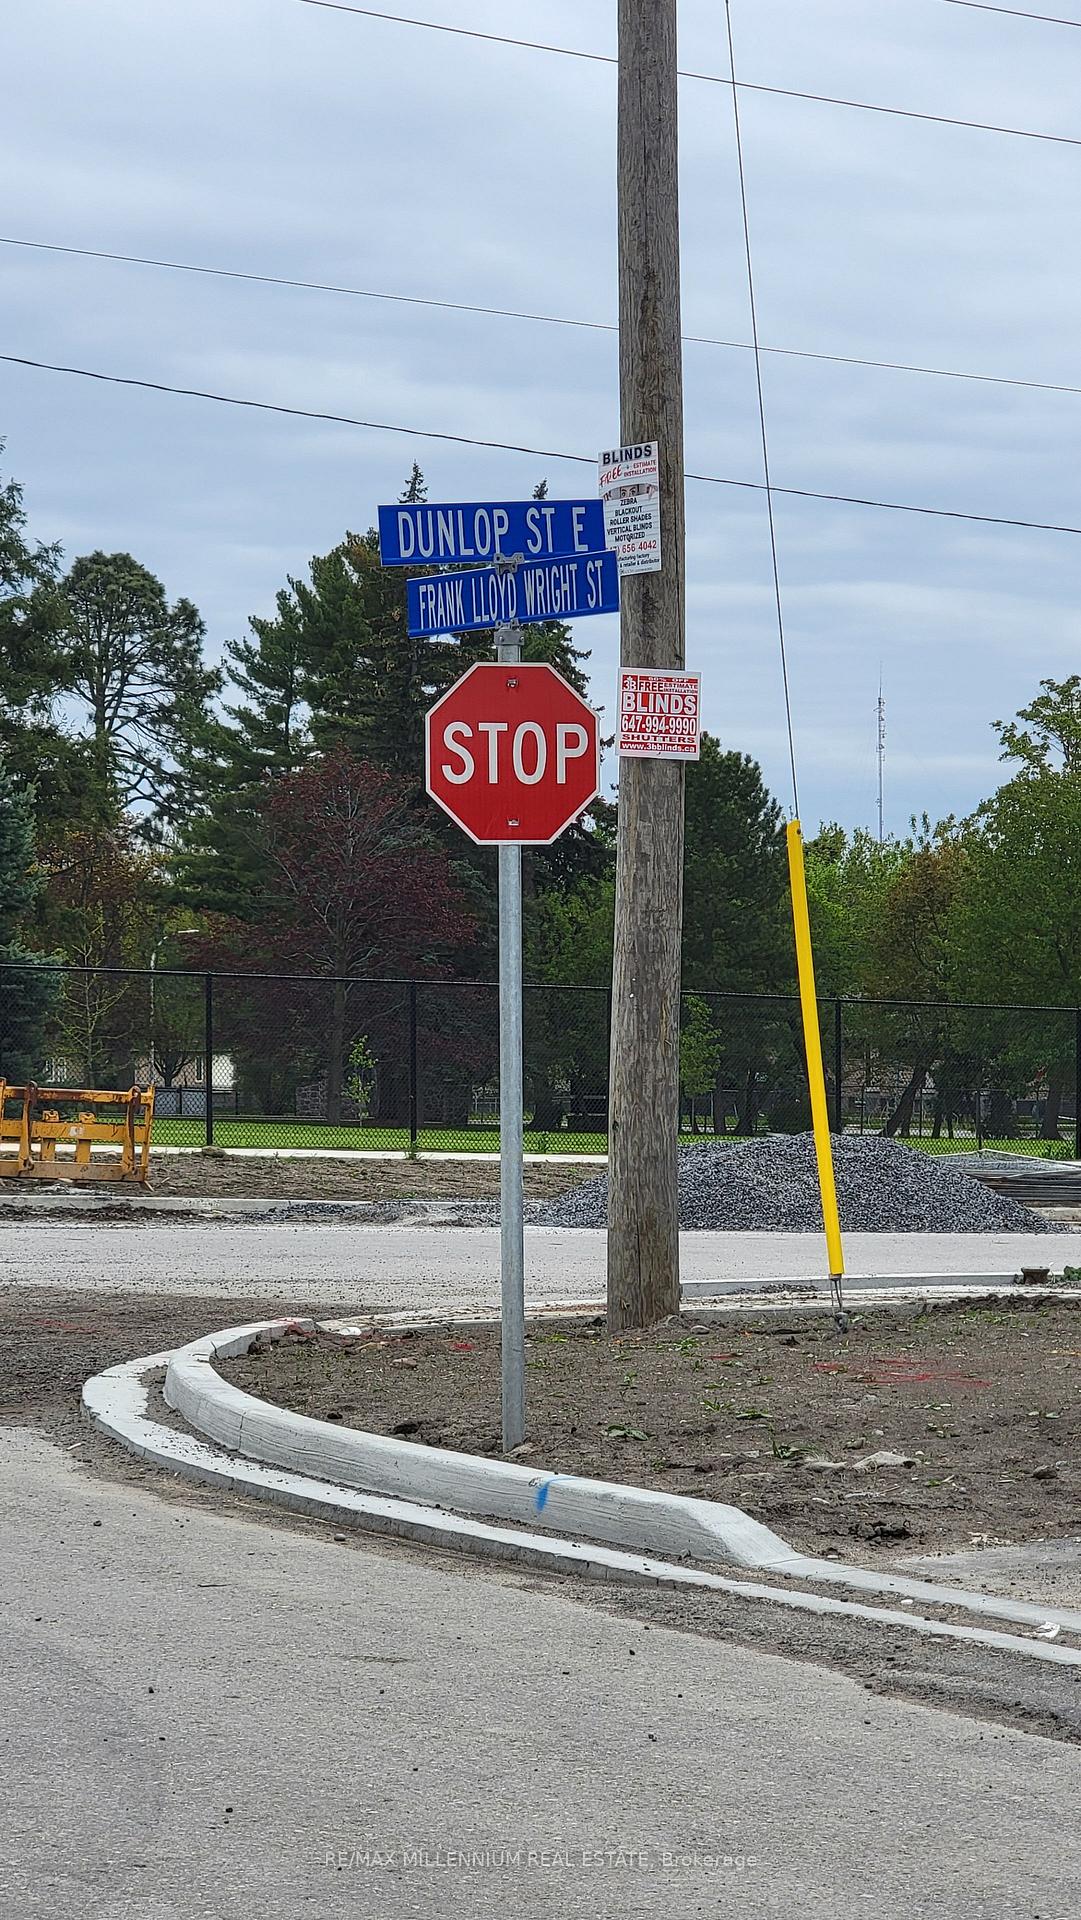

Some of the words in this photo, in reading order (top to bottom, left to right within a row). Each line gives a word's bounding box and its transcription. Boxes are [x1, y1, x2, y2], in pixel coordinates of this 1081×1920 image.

[603, 445, 652, 465] BLINDS
[599, 465, 622, 487] FREE
[633, 460, 656, 469] ESTIMATE
[624, 467, 657, 477] INSTALLATION
[620, 497, 637, 506] ZEBRA
[614, 506, 642, 517] BLACKOUT
[609, 516, 629, 527] ROLLER
[630, 513, 652, 523] SHADES
[398, 507, 509, 557] DUNLOP
[526, 507, 555, 554] ST
[572, 506, 588, 552] E
[606, 526, 631, 536] VERTICAL
[633, 522, 653, 531] BLINDS
[614, 532, 646, 542] MOTORIZED
[622, 543, 636, 554] 656
[638, 540, 657, 551] 4042
[419, 580, 465, 629] FRANK
[471, 570, 517, 622] LLOYD
[523, 563, 578, 616] WRIGHT
[586, 559, 603, 608] ST
[639, 682, 664, 692] FREE
[664, 682, 698, 690] ESTIMATE
[623, 692, 697, 715] BLINDS
[622, 714, 696, 735] 647-994-9990
[622, 733, 696, 743] SHUTTERS
[441, 721, 589, 785] STOP
[621, 742, 695, 753] www.3bblinds.ca
